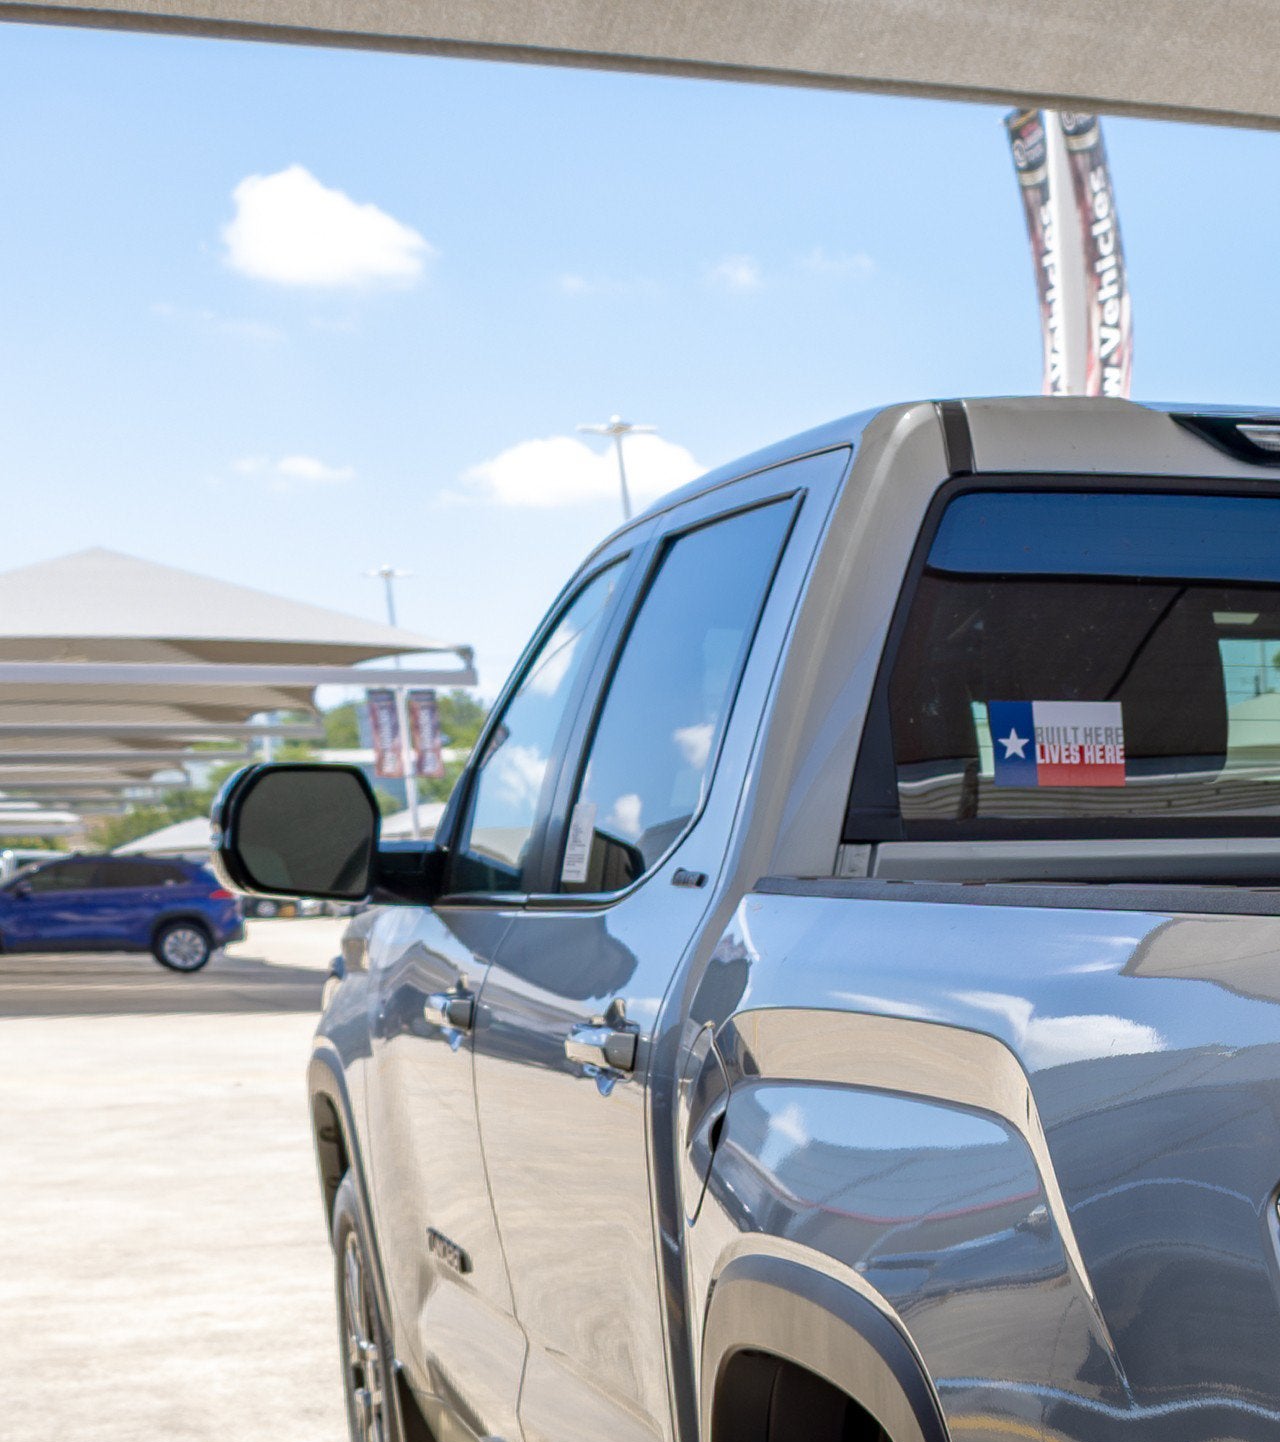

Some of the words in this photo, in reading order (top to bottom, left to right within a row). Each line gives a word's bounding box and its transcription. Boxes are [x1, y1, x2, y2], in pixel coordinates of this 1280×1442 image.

[1089, 165, 1121, 358] Vehicles
[1035, 727, 1080, 745] BUILT
[1084, 727, 1124, 745] HERE
[1036, 745, 1080, 764] LIVES
[1084, 744, 1125, 764] HERE
